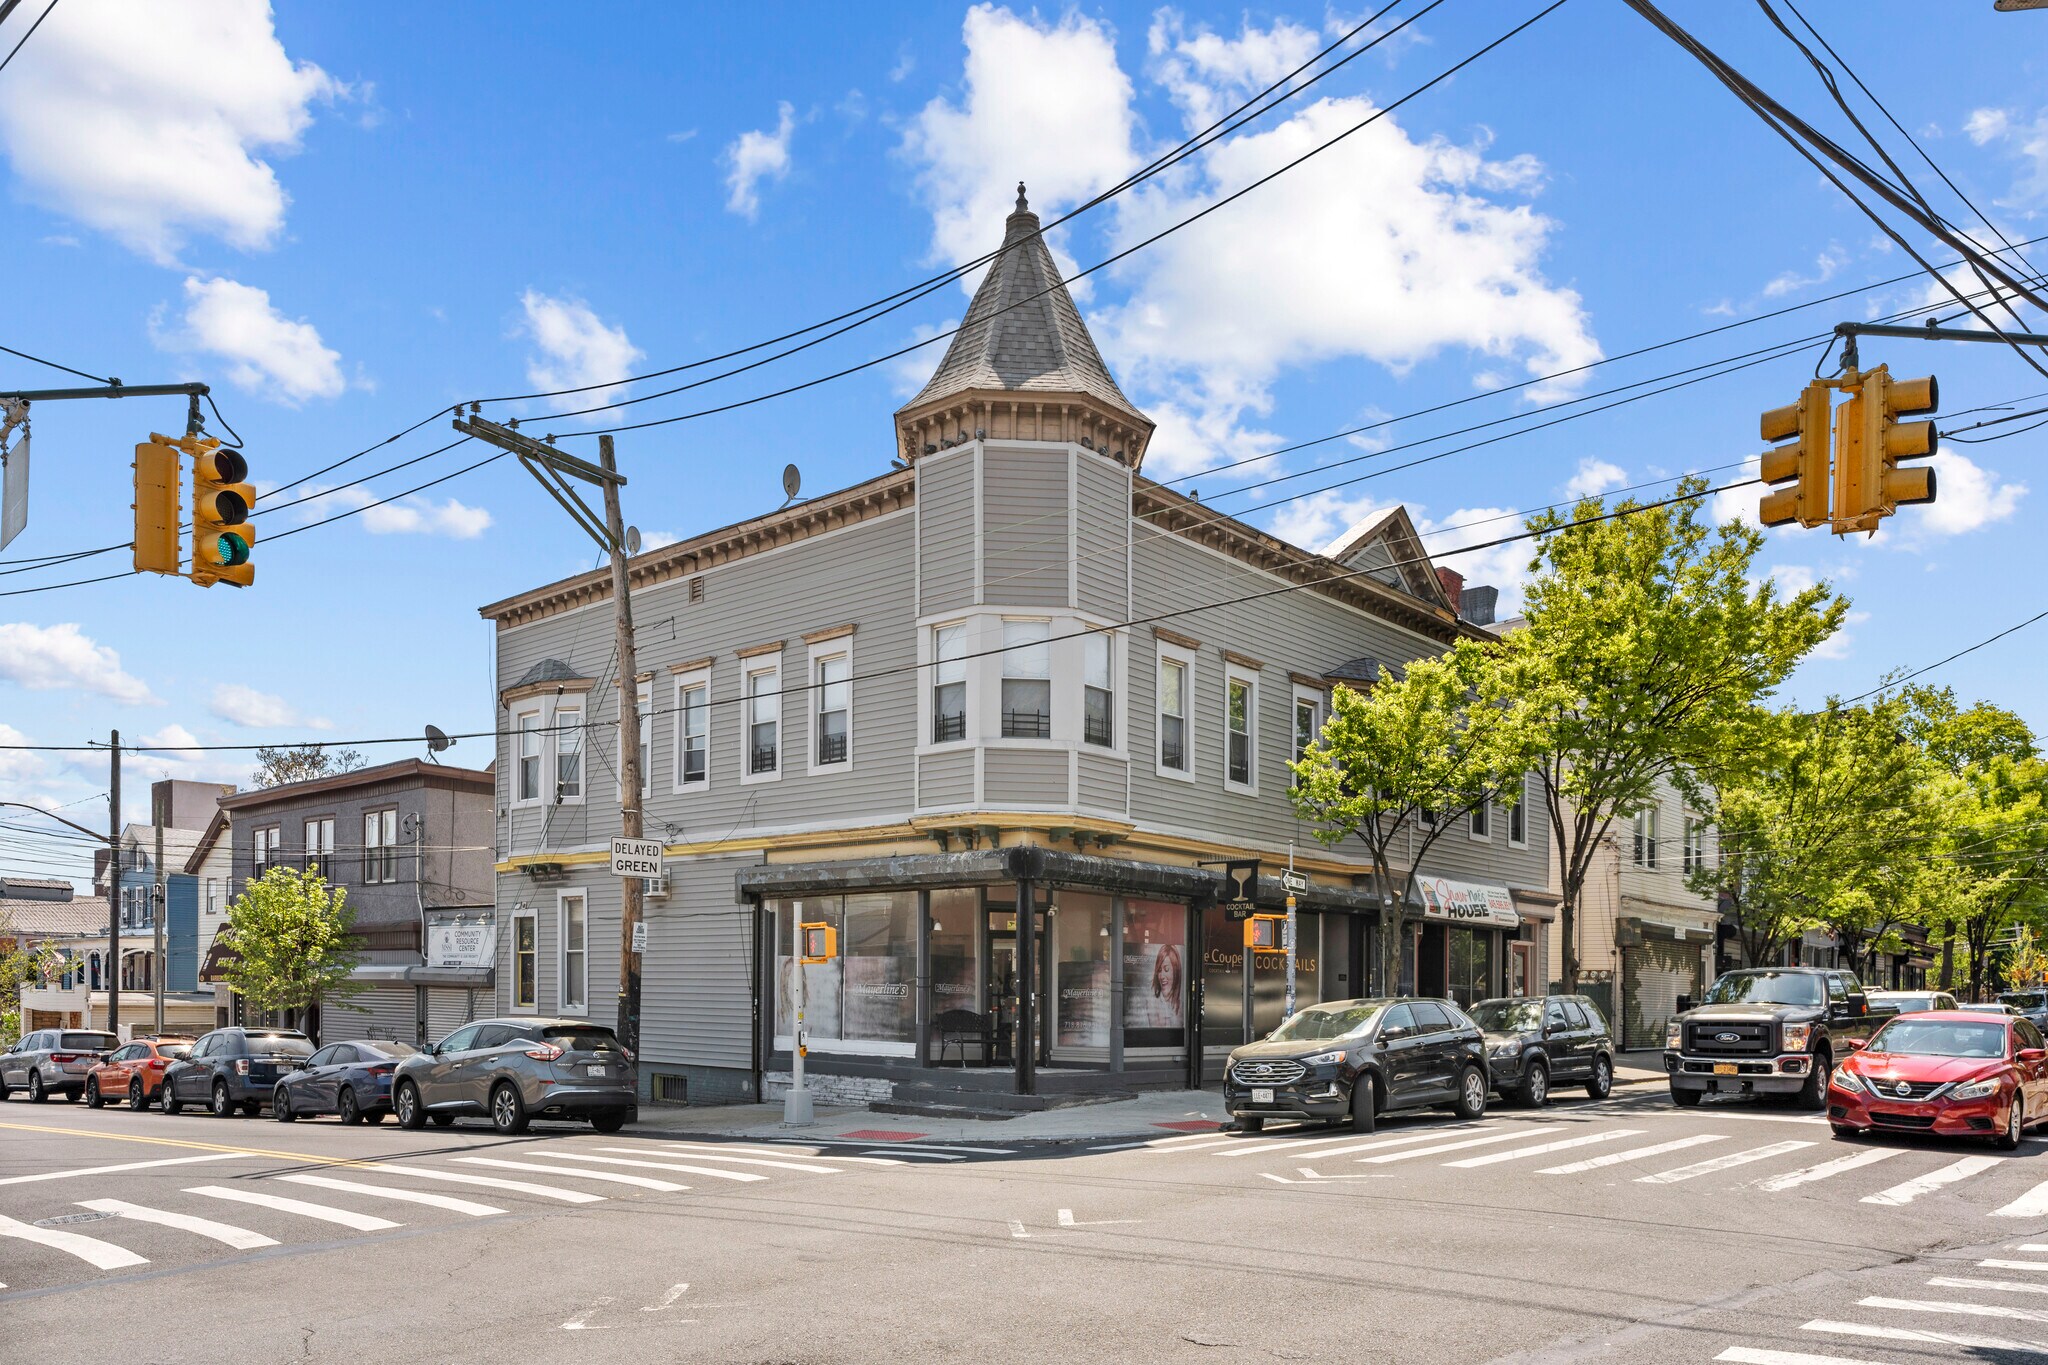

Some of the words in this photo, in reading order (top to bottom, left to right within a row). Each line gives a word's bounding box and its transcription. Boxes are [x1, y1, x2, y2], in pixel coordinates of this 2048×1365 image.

[615, 842, 659, 857] DELAYED
[616, 859, 658, 873] GREEN
[1295, 879, 1305, 888] WAY
[1226, 902, 1256, 911] COCKTAIL
[1448, 901, 1490, 919] HOUSE
[1211, 948, 1243, 968] Coupe
[1255, 955, 1317, 973] COCKAILS
[855, 982, 907, 999] Mayerline's
